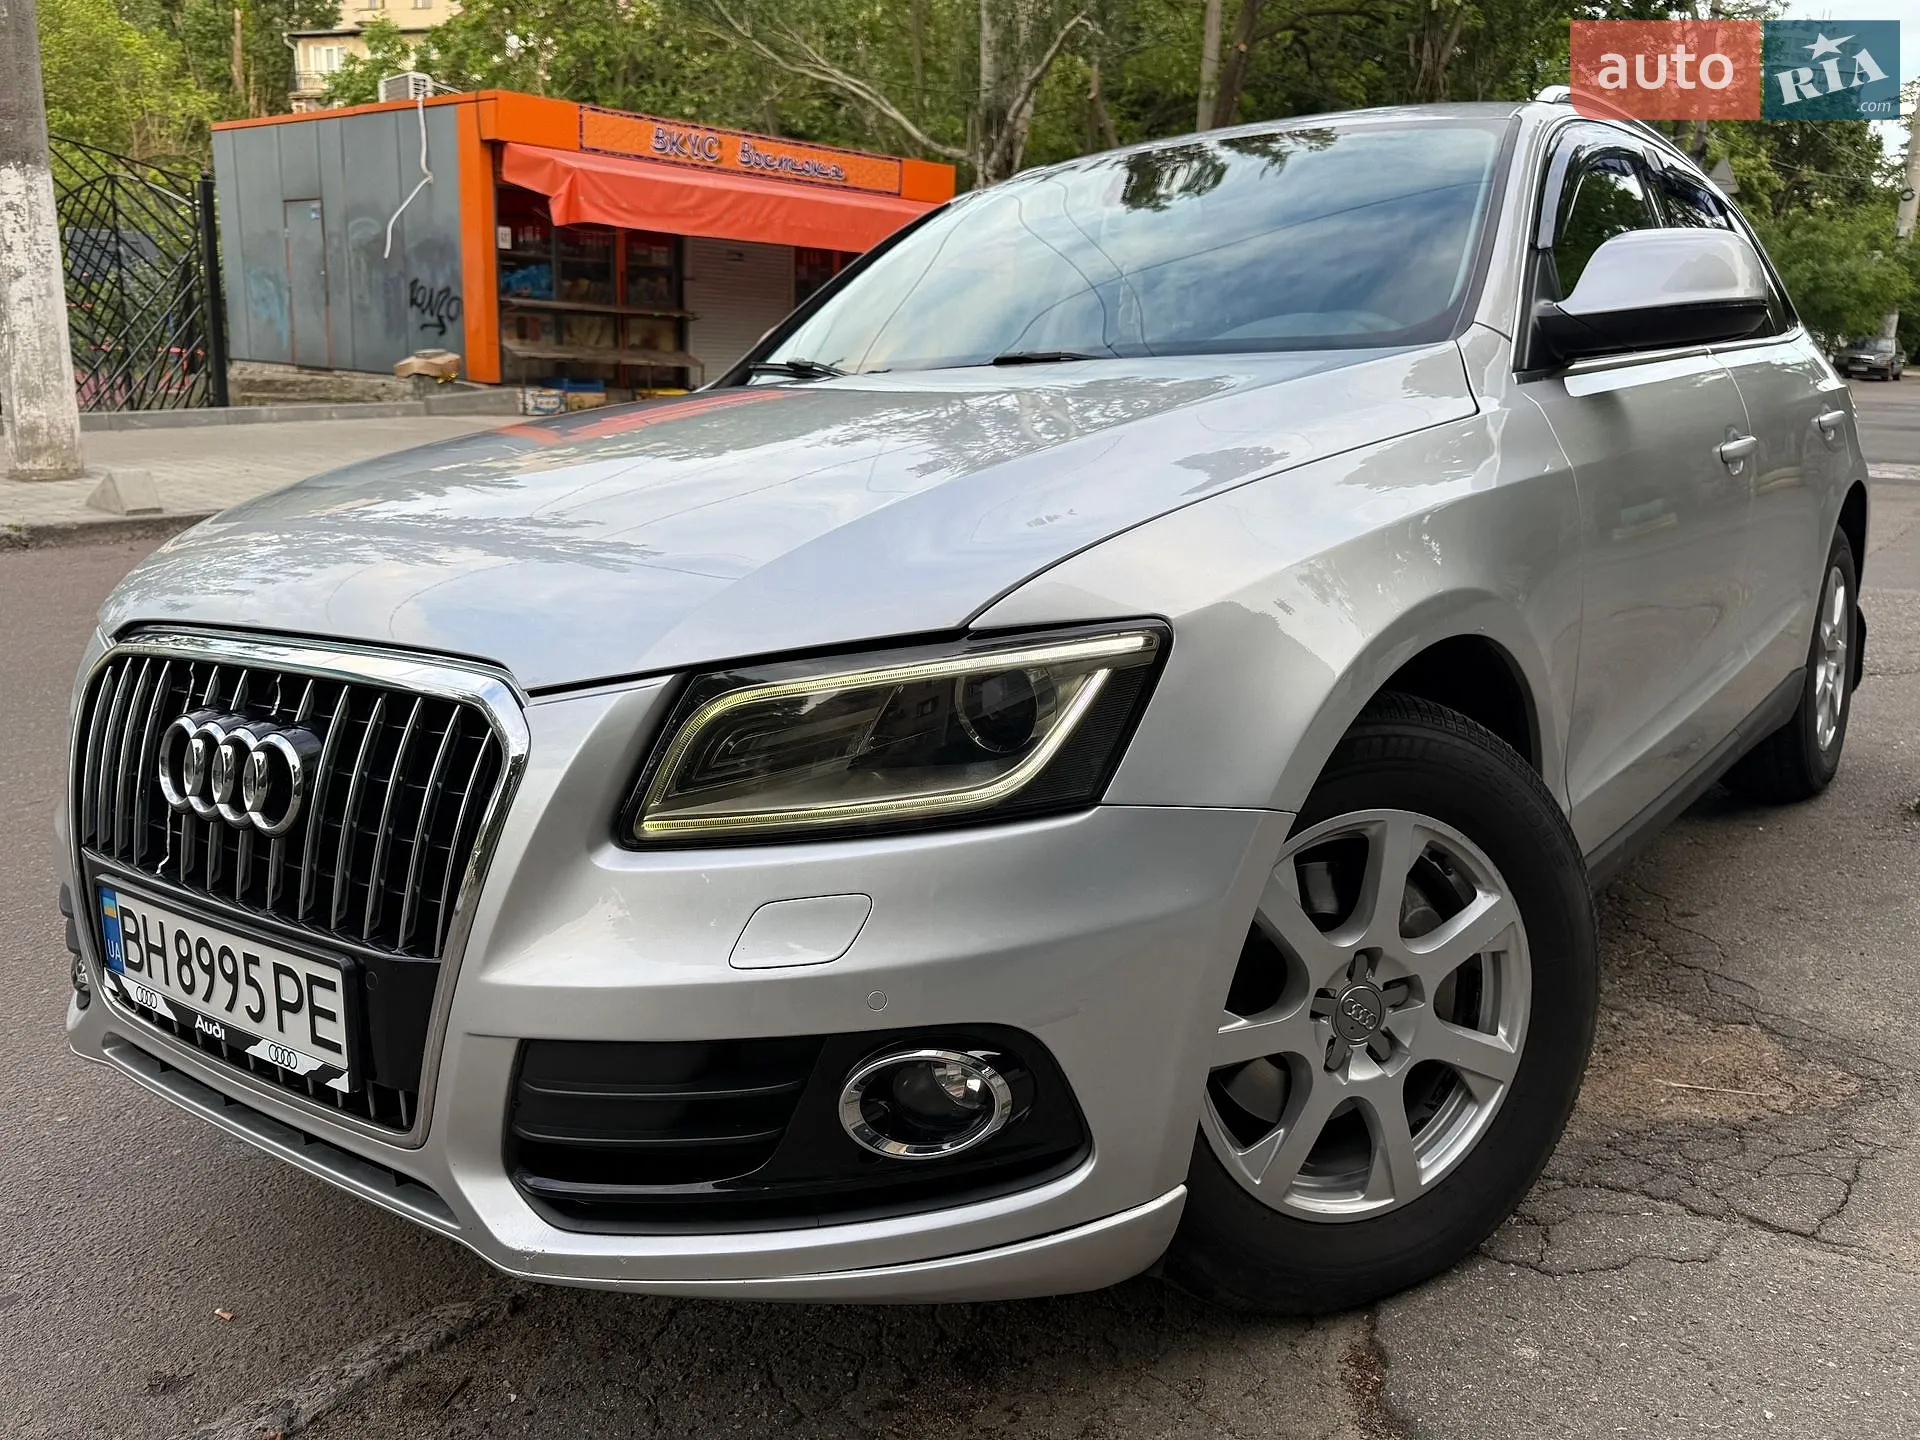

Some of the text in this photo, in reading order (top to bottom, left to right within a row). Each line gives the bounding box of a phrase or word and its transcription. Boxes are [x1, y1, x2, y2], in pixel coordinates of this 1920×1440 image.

[652, 126, 719, 161] ВКУС
[107, 939, 122, 962] UA
[194, 1014, 225, 1040] Audi
